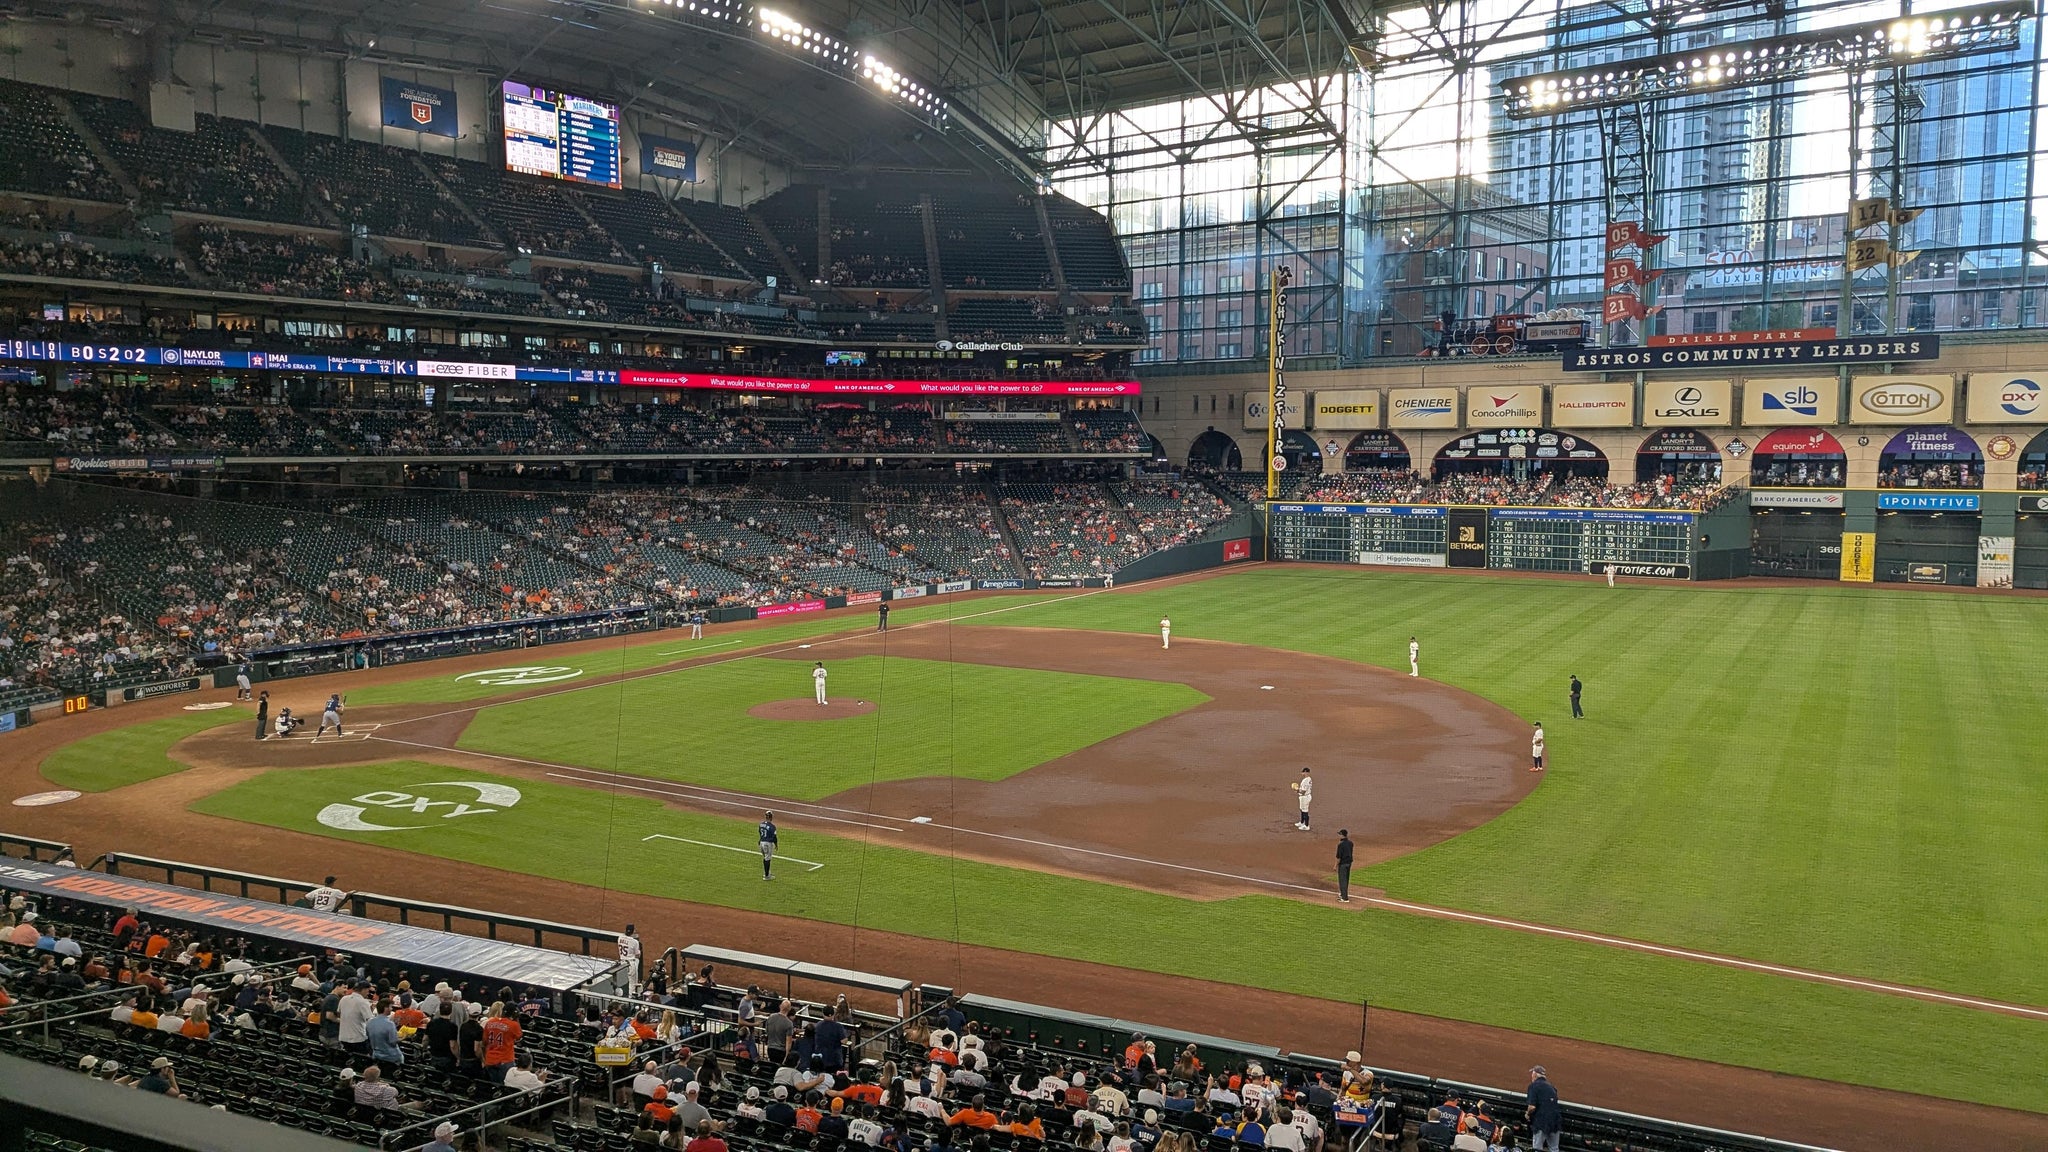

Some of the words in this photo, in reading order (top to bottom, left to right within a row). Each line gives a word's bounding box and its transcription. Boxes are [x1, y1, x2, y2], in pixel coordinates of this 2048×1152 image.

[400, 93, 442, 106] FOUNDATION
[572, 102, 604, 117] MARINERS
[665, 152, 686, 162] YOUTH
[653, 157, 686, 169] ACADEMY
[1858, 203, 1878, 221] 17
[1612, 227, 1630, 243] 05
[1855, 247, 1875, 262] 22
[1612, 264, 1629, 279] 19
[1609, 299, 1626, 314] 21
[1275, 293, 1288, 370] CHIKIN
[1540, 328, 1557, 337] BRING
[1668, 333, 1737, 344] DAIKIN
[1753, 331, 1801, 340] PARK
[32, 345, 41, 356] L
[955, 341, 1000, 352] Gallagher
[1001, 341, 1023, 351] Club
[109, 347, 120, 361] 2
[135, 348, 146, 362] 2
[183, 350, 221, 360] NAYLOR
[268, 354, 288, 363] IMAI
[1576, 352, 1651, 367] ASTROS
[1662, 347, 1801, 364] COMMUNITY
[1812, 342, 1920, 357] LEADERS
[337, 363, 343, 371] 4
[359, 364, 365, 372] 8
[380, 365, 390, 373] 12
[397, 360, 406, 374] K
[436, 364, 464, 375] ezee
[468, 367, 508, 377] FIBER
[710, 378, 726, 386] What
[727, 379, 744, 387] would
[921, 384, 938, 392] What
[940, 384, 959, 392] would
[960, 385, 973, 393] you
[974, 384, 986, 392] like
[987, 384, 999, 392] the
[1000, 385, 1020, 393] power
[1031, 384, 1043, 392] do?
[1784, 386, 1818, 405] slb
[1870, 390, 1931, 408] COTTON
[2002, 393, 2040, 402] OXY
[1395, 398, 1452, 408] CHENIERE
[1559, 401, 1626, 409] HALLIBURTON
[1320, 405, 1374, 414] DOGGETT
[1472, 408, 1537, 418] ConocoPhillips
[1655, 408, 1720, 418] LEXUS
[1274, 401, 1286, 454] FAIR
[1906, 432, 1948, 443] planet
[1772, 442, 1807, 452] equinor
[1911, 442, 1956, 451] fitness
[69, 457, 110, 470] Rookies
[1884, 497, 1974, 507] 1POINTFIVE
[1450, 542, 1484, 550] BETMGM
[1819, 546, 1841, 554] 366
[1386, 556, 1431, 564] Higginbotham
[1854, 534, 1862, 576] DOGGETT
[1981, 553, 2010, 561] WM
[1603, 565, 1676, 578] NTTOTIRE.COM
[145, 680, 190, 693] WOODFOREST
[352, 790, 498, 818] OXY
[316, 896, 330, 906] 23
[41, 875, 229, 913] HOUSTON
[204, 905, 385, 942] ASTROS
[488, 1031, 503, 1048] 44
[1098, 1089, 1117, 1098] VALDEZ
[1098, 1099, 1114, 1113] 59
